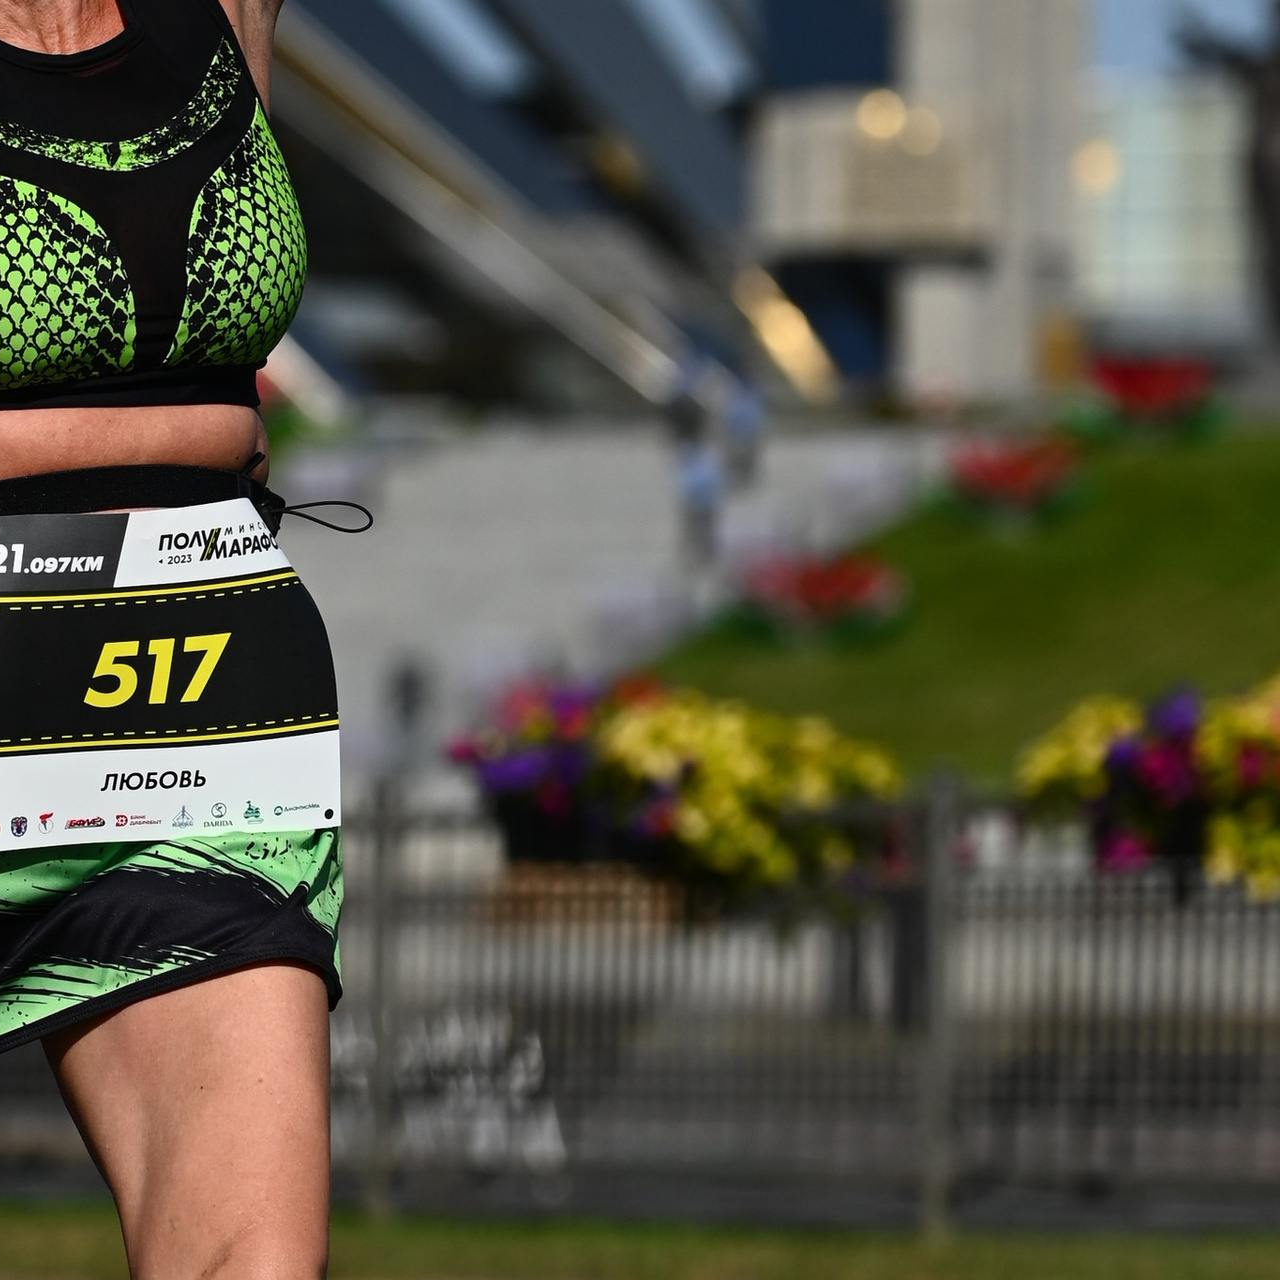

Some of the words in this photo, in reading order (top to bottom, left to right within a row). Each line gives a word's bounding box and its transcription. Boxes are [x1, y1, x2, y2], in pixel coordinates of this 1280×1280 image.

[167, 554, 192, 565] 2023
[83, 631, 232, 708] 517
[100, 769, 207, 792] ЛЮБОВЬ
[203, 820, 233, 828] DARIDA
